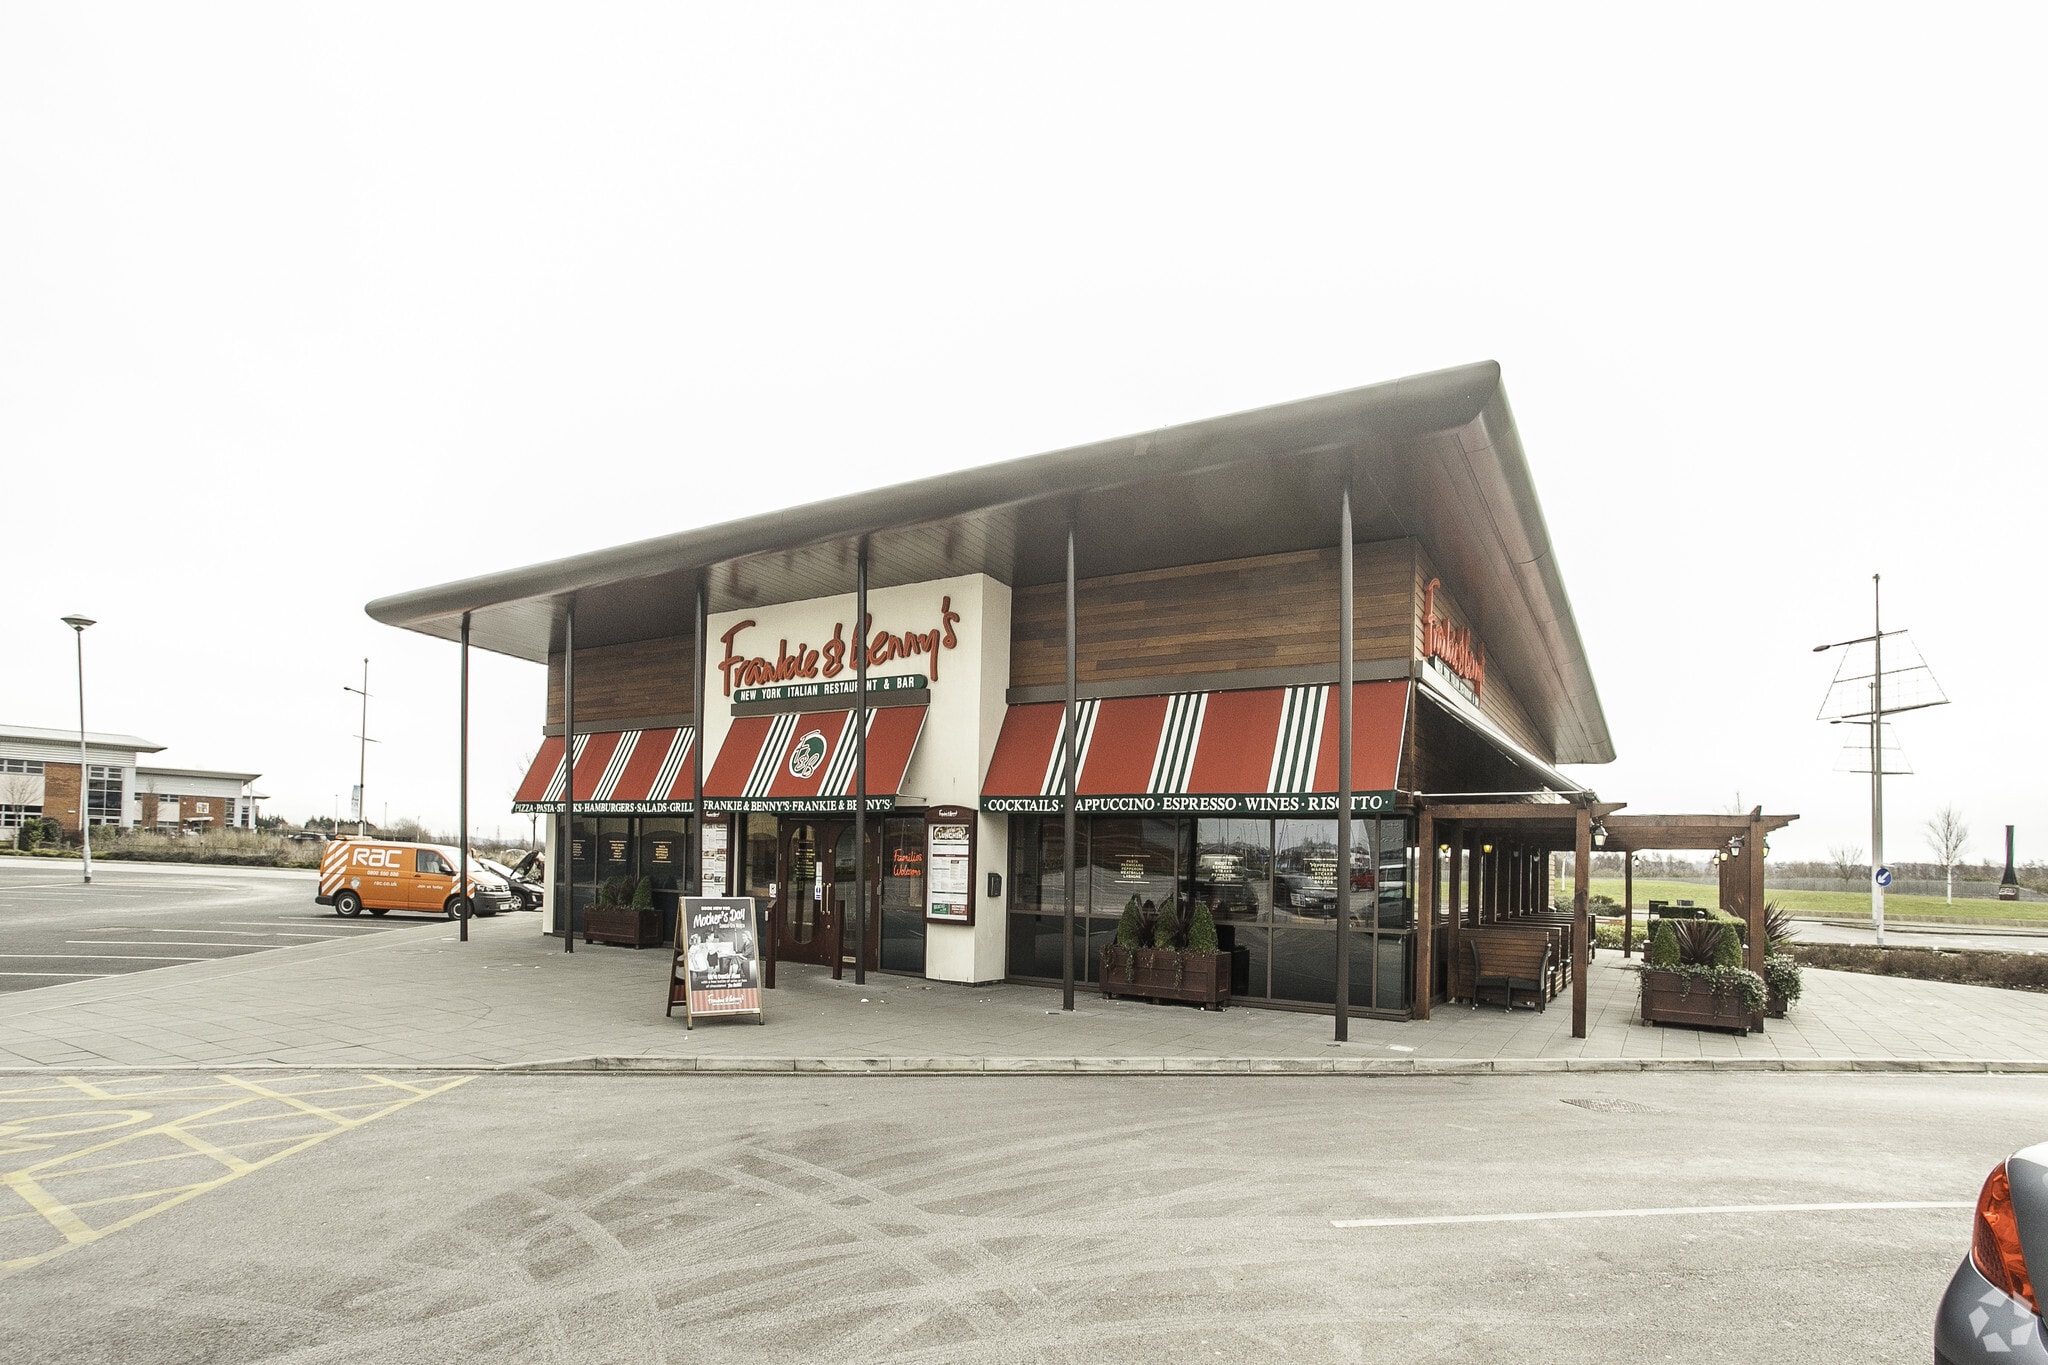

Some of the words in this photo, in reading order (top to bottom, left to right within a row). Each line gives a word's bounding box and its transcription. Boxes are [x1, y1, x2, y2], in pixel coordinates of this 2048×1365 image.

[718, 619, 820, 697] Frankie
[822, 622, 846, 678] &
[740, 690, 757, 701] NEW
[762, 688, 782, 699] YORK
[787, 685, 818, 697] ITALIAN
[824, 677, 877, 694] RESTAURNT
[883, 678, 890, 689] &
[896, 676, 915, 688] BAR
[514, 803, 534, 812] PIZZA
[536, 803, 555, 812] PASTA
[556, 803, 582, 812] STKS
[584, 802, 635, 812] HAMBURGERS
[637, 802, 668, 812] SALADS
[703, 799, 742, 811] FRANKIE
[743, 801, 750, 811] &
[751, 800, 790, 811] BENNY'S
[792, 799, 837, 811] FRANKIE
[838, 800, 845, 810] &
[846, 799, 891, 810] BENY'S
[988, 799, 1059, 811] COCKTAILS
[1074, 798, 1155, 811] APPUCCINO
[1162, 797, 1236, 811] ESPRESSO
[1245, 797, 1299, 810] WINES
[1308, 795, 1382, 810] RISTTO
[693, 910, 729, 929] Mother's
[729, 908, 746, 921] Day
